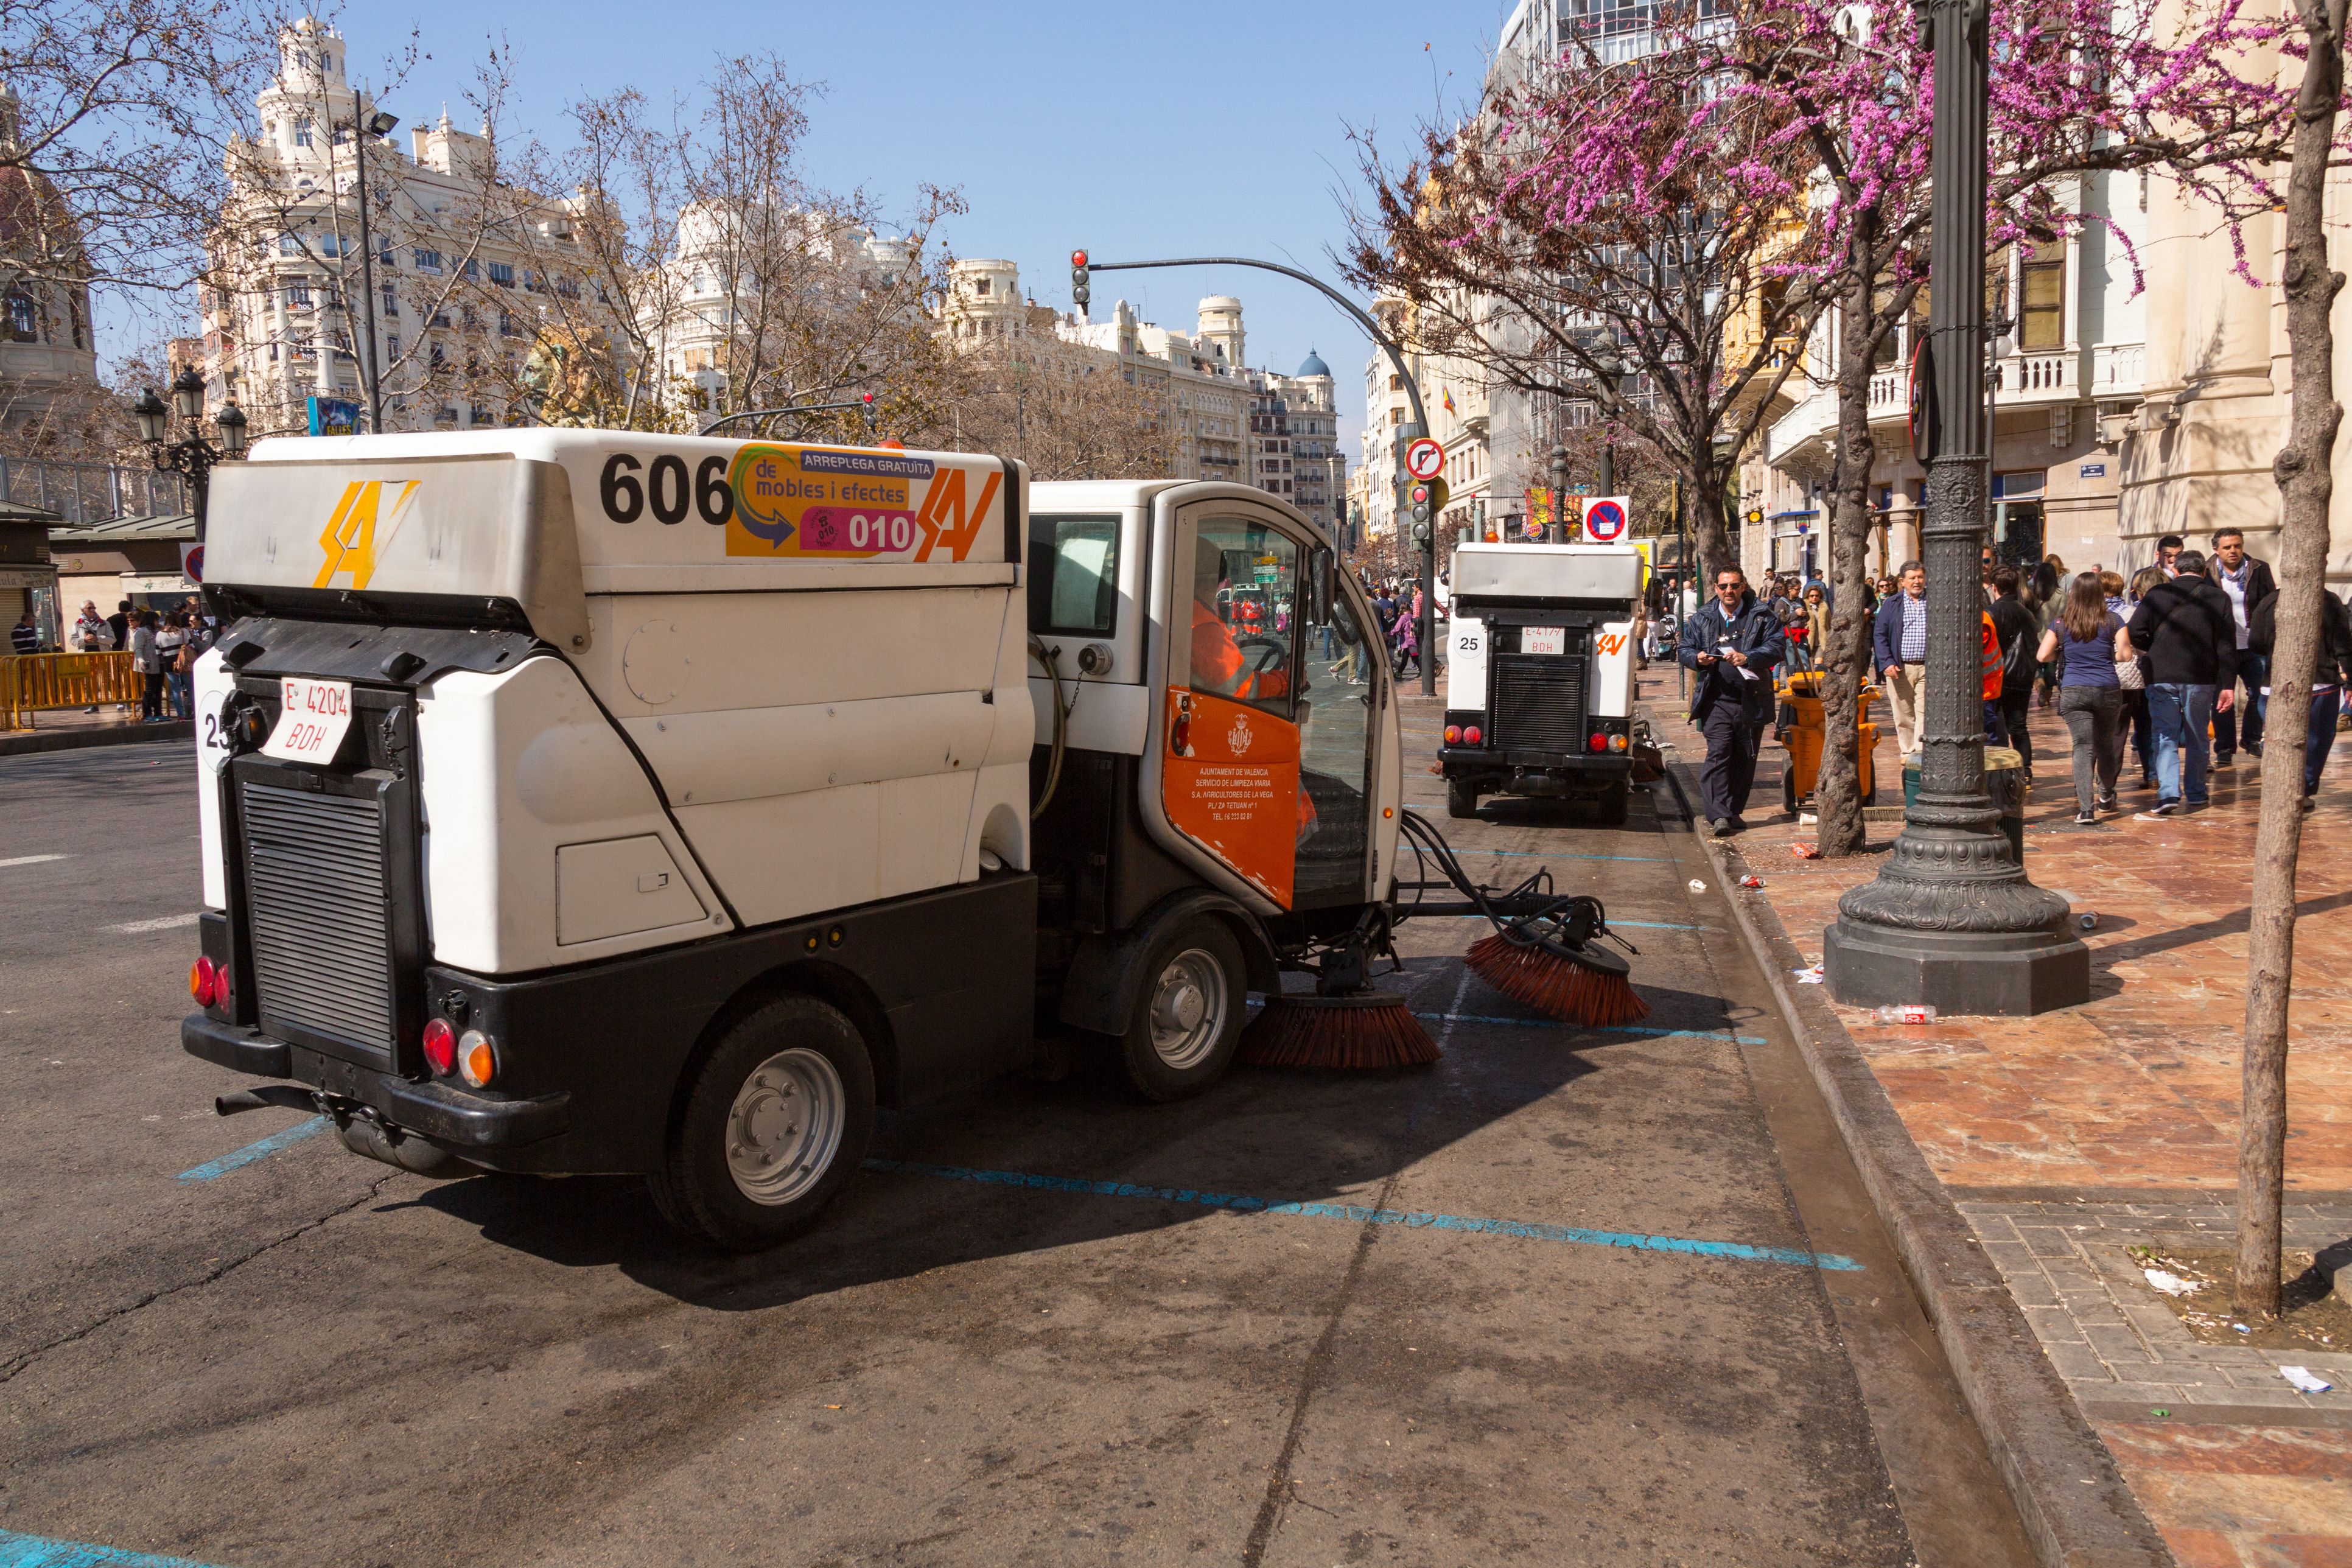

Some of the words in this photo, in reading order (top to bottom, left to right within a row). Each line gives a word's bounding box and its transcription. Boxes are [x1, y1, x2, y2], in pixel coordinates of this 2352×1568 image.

[327, 424, 351, 435] FALLES
[756, 459, 777, 479] de
[805, 454, 875, 471] ARREPLEGA
[878, 460, 931, 475] GRATUÏTA
[600, 453, 734, 525] 606
[755, 478, 824, 499] mobles
[830, 481, 835, 500] i
[841, 482, 905, 503] efectes
[819, 525, 835, 540] 010
[849, 514, 909, 548] 010
[1536, 626, 1562, 637] 4177
[1460, 637, 1479, 651] 25
[1532, 642, 1553, 653] BDH
[286, 683, 295, 710] E
[307, 685, 348, 716] 4204
[285, 723, 327, 752] BDH
